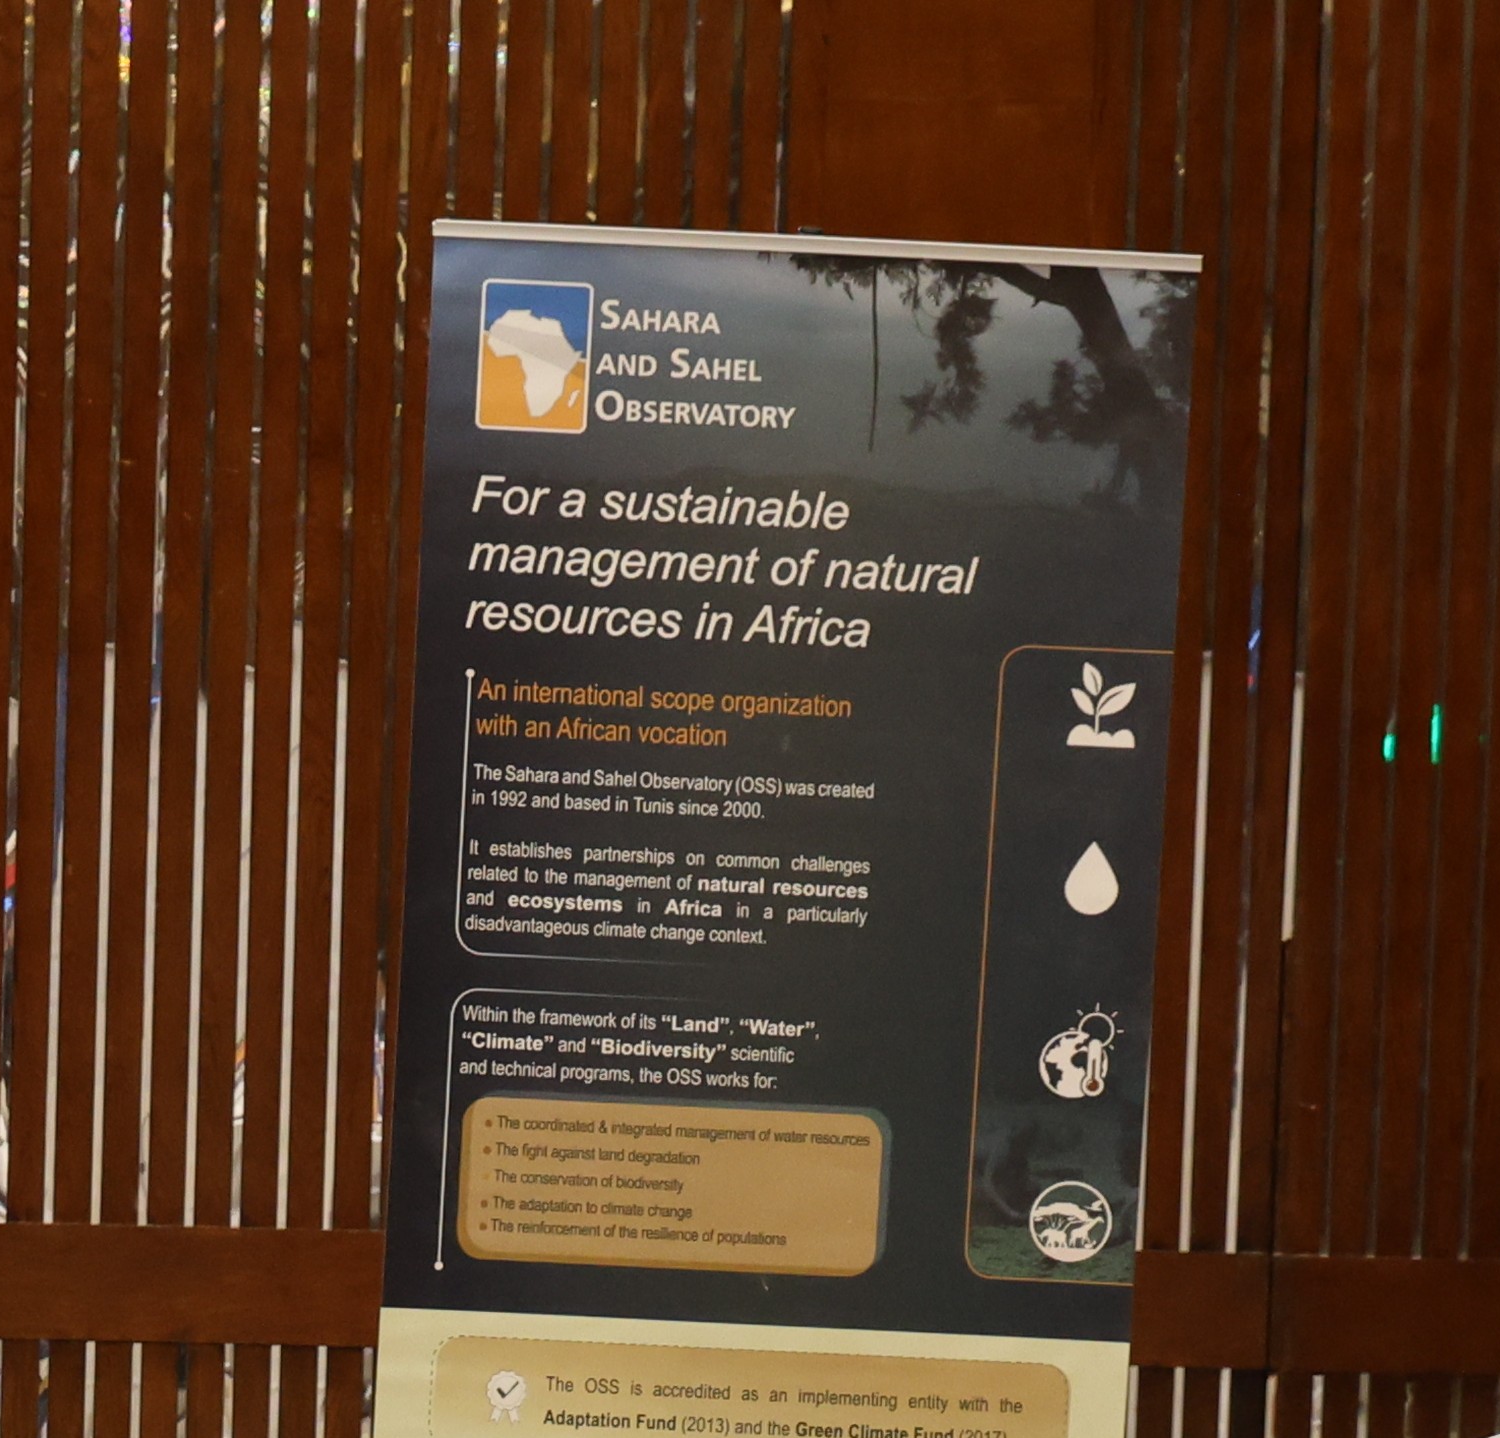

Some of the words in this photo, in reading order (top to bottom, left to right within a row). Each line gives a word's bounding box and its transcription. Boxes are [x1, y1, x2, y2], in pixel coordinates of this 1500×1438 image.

[472, 475, 550, 515] For
[559, 489, 586, 518] a
[600, 486, 849, 530] sustainable
[469, 543, 760, 587] management
[771, 548, 819, 586] of
[824, 554, 979, 594] natural
[466, 601, 683, 639] resources
[695, 602, 733, 641] in
[743, 605, 870, 647] Africa
[477, 678, 506, 701] An
[513, 680, 644, 708] international
[651, 692, 715, 715] scope
[721, 693, 851, 719] organization
[476, 713, 517, 736] with
[525, 720, 551, 738] an
[556, 717, 630, 742] African
[638, 723, 727, 746] vocation
[474, 763, 502, 781] The
[505, 765, 559, 784] Sahara
[562, 769, 591, 785] and
[593, 769, 637, 787] Sahel
[640, 771, 733, 796] Observatory
[735, 776, 782, 798] (OSS)
[785, 783, 815, 796] was
[818, 783, 875, 799] created
